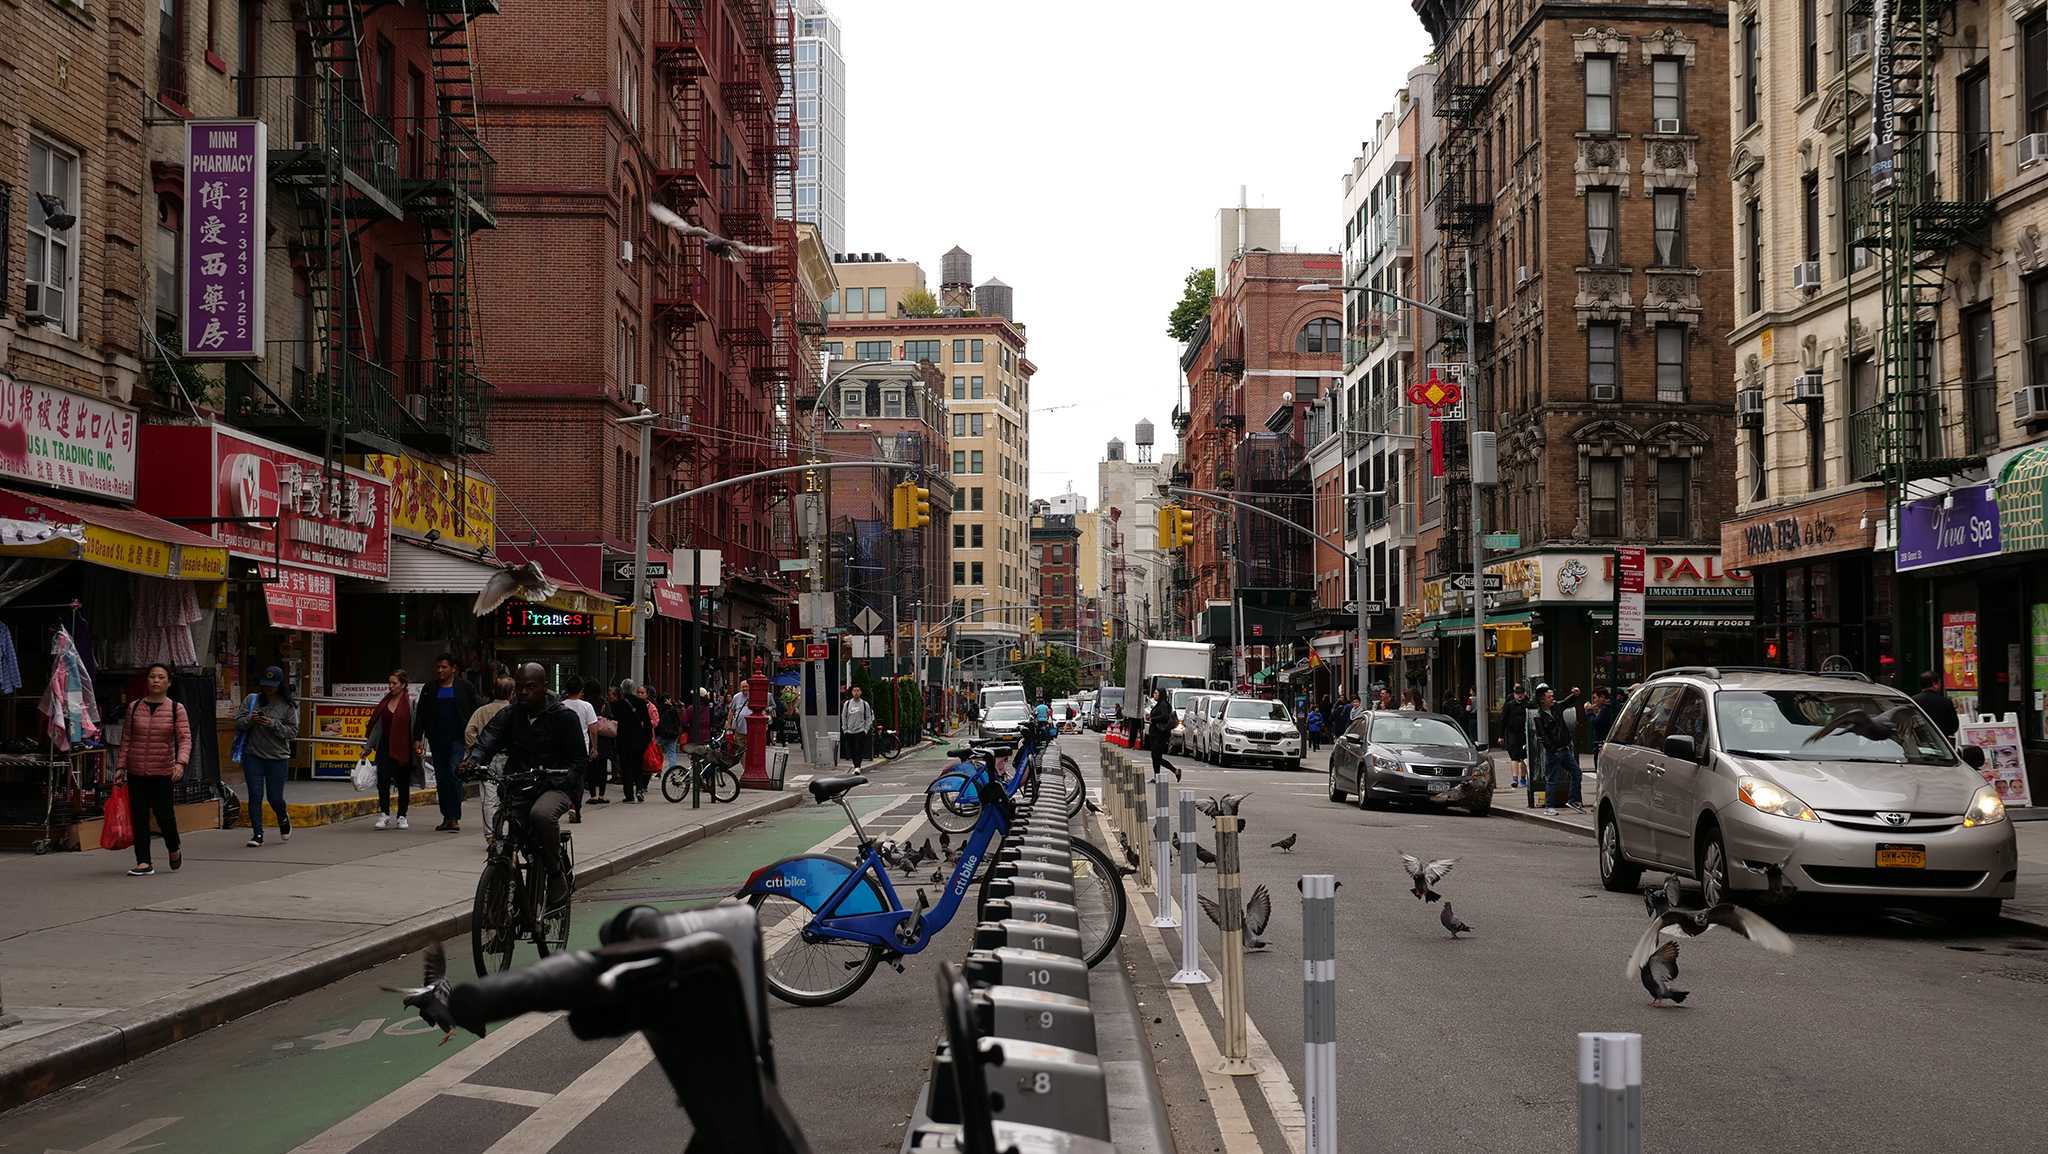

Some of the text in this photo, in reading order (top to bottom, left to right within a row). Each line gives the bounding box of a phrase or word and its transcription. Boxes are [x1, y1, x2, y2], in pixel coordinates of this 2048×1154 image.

[208, 131, 238, 148] MINH
[193, 154, 253, 172] PHARMACY
[196, 180, 231, 349] 博愛西藥房
[27, 434, 115, 472] USA TRADING INC.
[299, 518, 368, 554] MINH PHARMACY
[1775, 514, 1801, 551] TEA
[1932, 504, 1992, 550] Viva Spa
[183, 553, 220, 574] lesale-Retail
[1653, 557, 1754, 582] PAL
[1650, 588, 1694, 596] IMPORTED
[1696, 588, 1733, 596] ITALIAN
[521, 607, 583, 626] Frames
[346, 726, 359, 734] RUB
[1033, 890, 1046, 900] 13
[1033, 912, 1047, 922] 12
[1032, 936, 1045, 950] 11
[1028, 969, 1050, 985] 10
[1040, 1011, 1053, 1028] 9
[1034, 1072, 1051, 1094] 8
